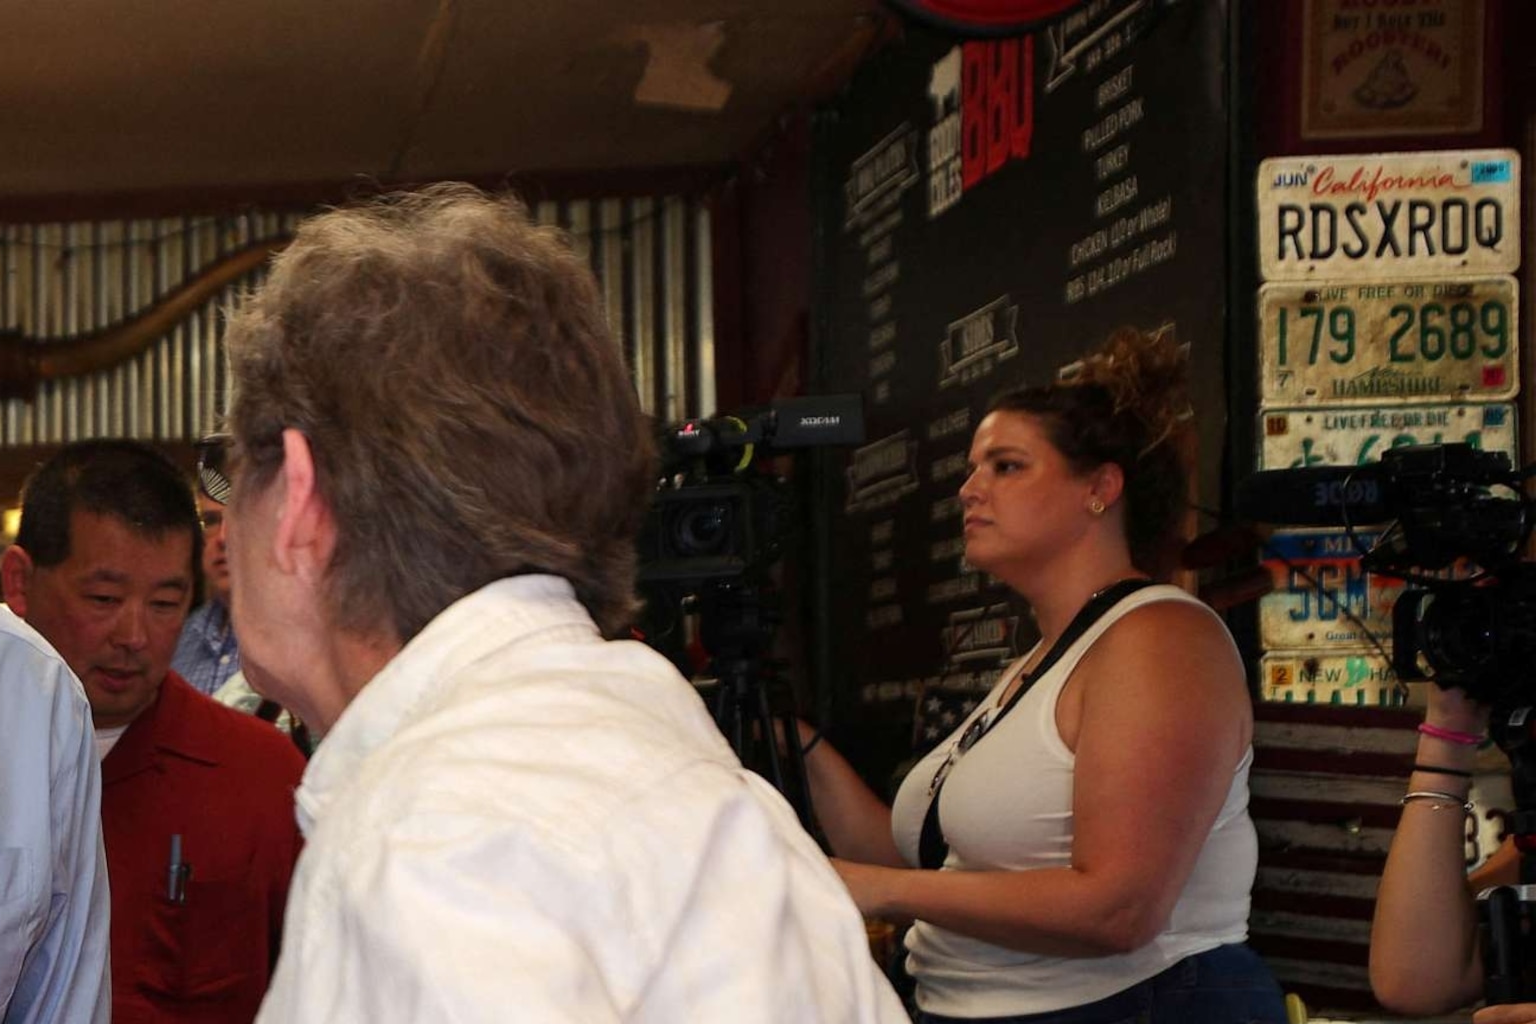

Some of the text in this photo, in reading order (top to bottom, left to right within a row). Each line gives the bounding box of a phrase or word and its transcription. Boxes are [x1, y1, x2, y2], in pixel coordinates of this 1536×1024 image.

[1273, 171, 1308, 188] JUN
[1313, 167, 1471, 201] California
[1319, 287, 1347, 301] LIVE
[1359, 285, 1395, 299] FREE
[1405, 285, 1424, 298] OR
[1389, 300, 1508, 363] 2689
[1325, 411, 1449, 430] LIVE FREE OR DIE
[1299, 668, 1341, 682] NEW
